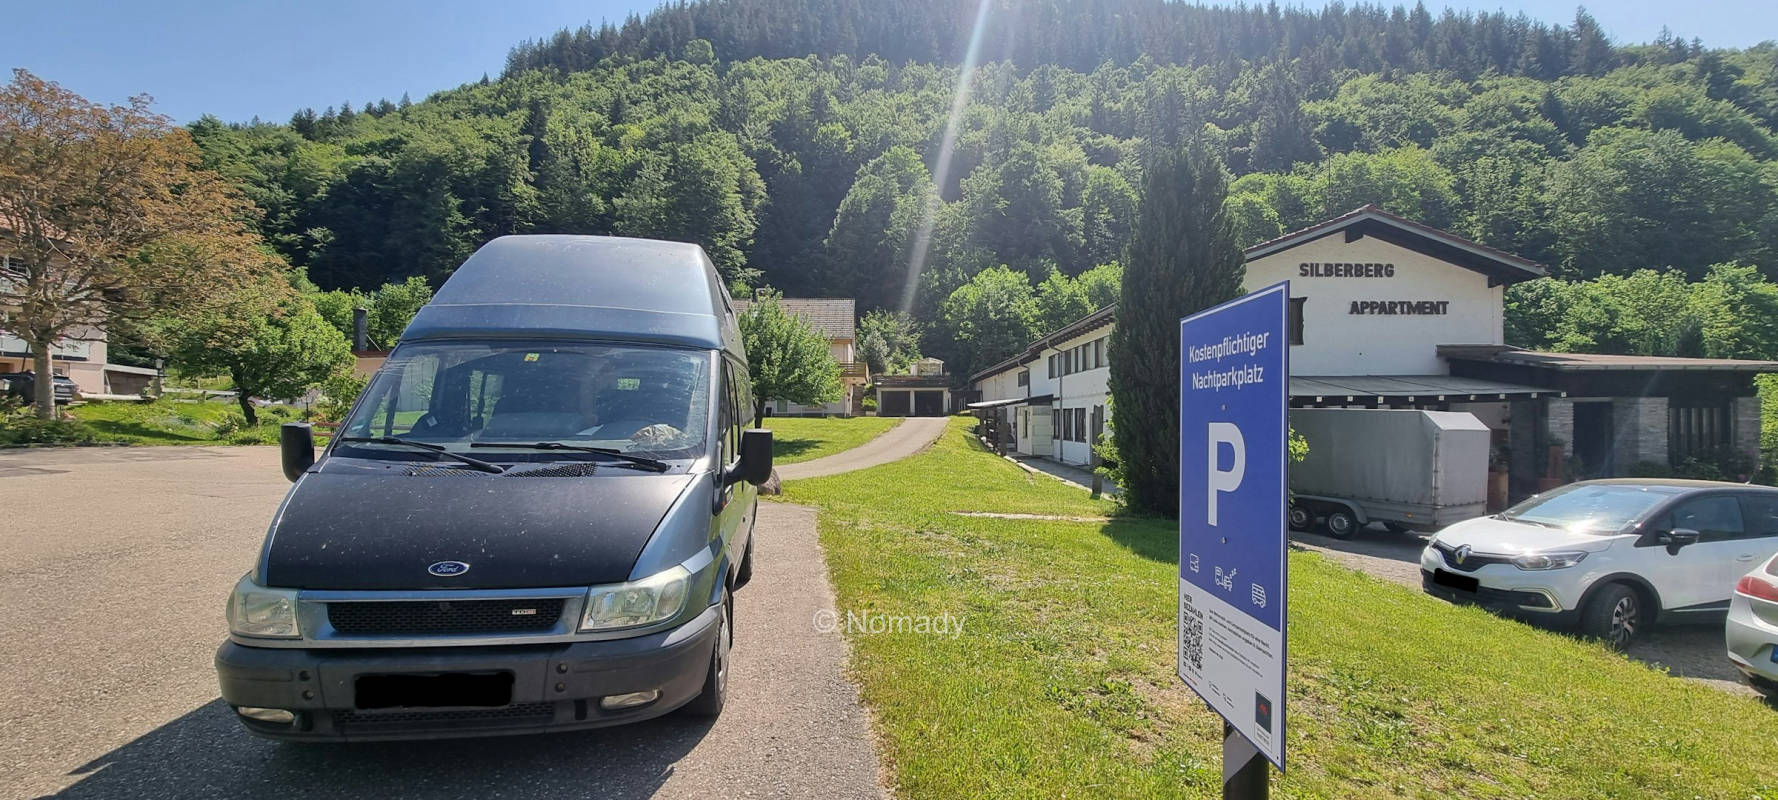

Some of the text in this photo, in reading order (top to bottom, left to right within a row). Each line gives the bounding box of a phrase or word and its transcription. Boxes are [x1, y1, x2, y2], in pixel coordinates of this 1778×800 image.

[1299, 262, 1395, 278] SILBERBERG
[1349, 300, 1450, 315] APPARTMENT
[1189, 331, 1270, 363] Kostenpflichtiger
[1192, 364, 1264, 392] Nachtparkplatz
[1207, 422, 1246, 527] P
